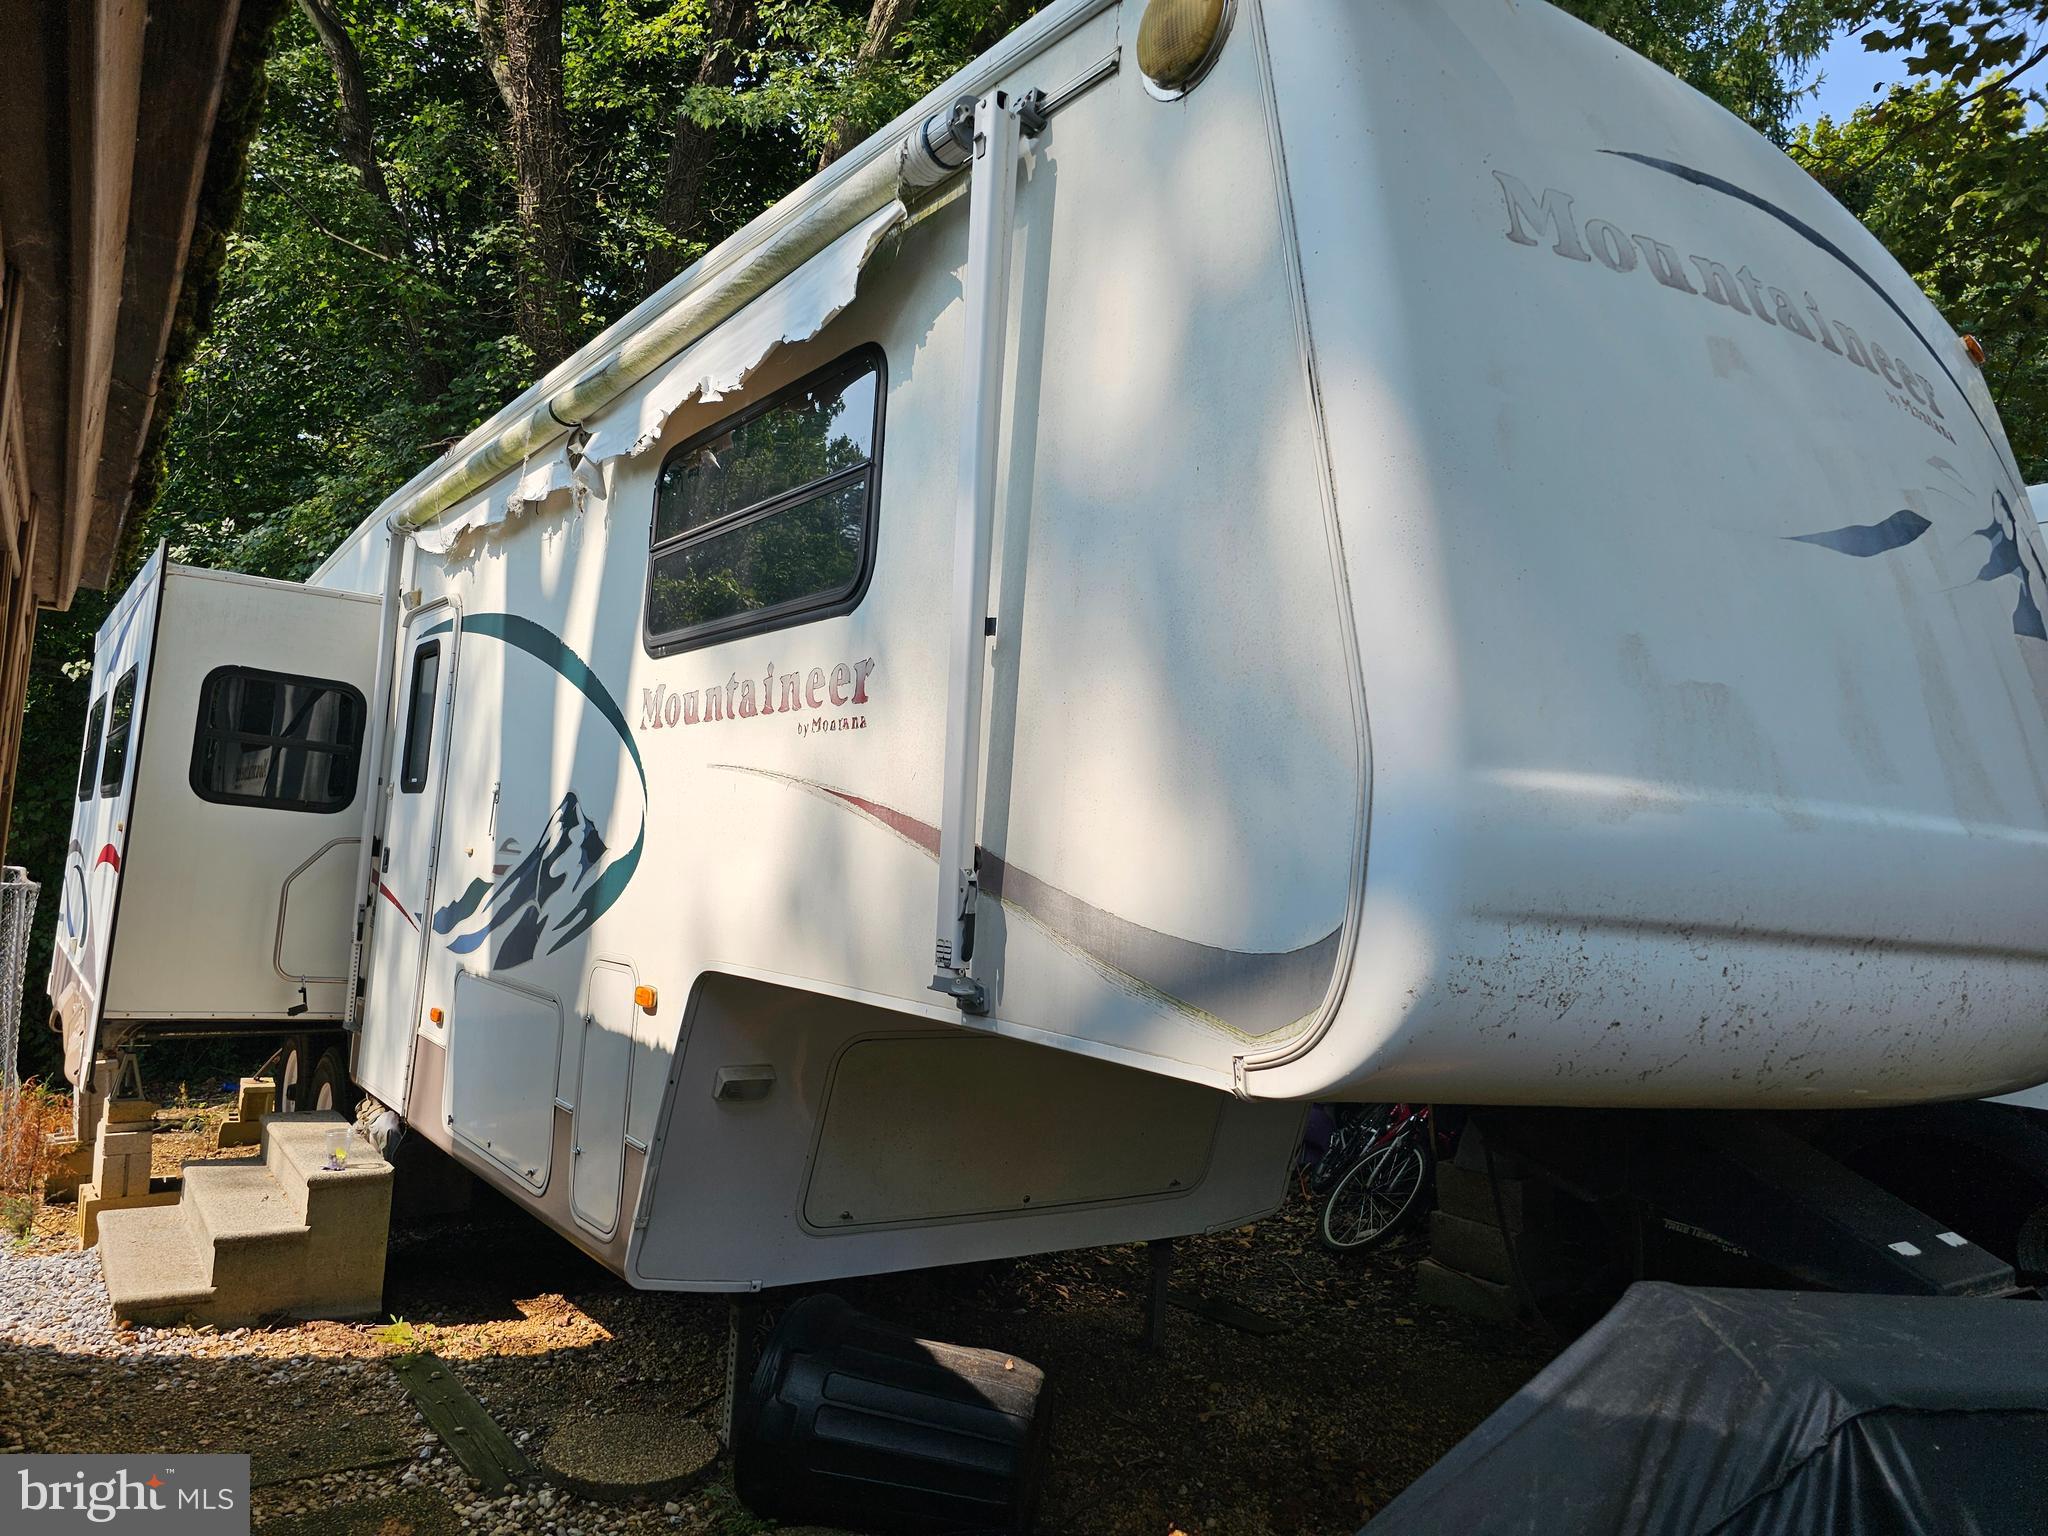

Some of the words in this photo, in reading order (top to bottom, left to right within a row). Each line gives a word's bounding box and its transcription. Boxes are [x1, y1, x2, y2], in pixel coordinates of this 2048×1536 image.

[1490, 169, 1945, 419] Mountaineer
[639, 656, 876, 731] Mountaineer
[797, 721, 810, 738] by
